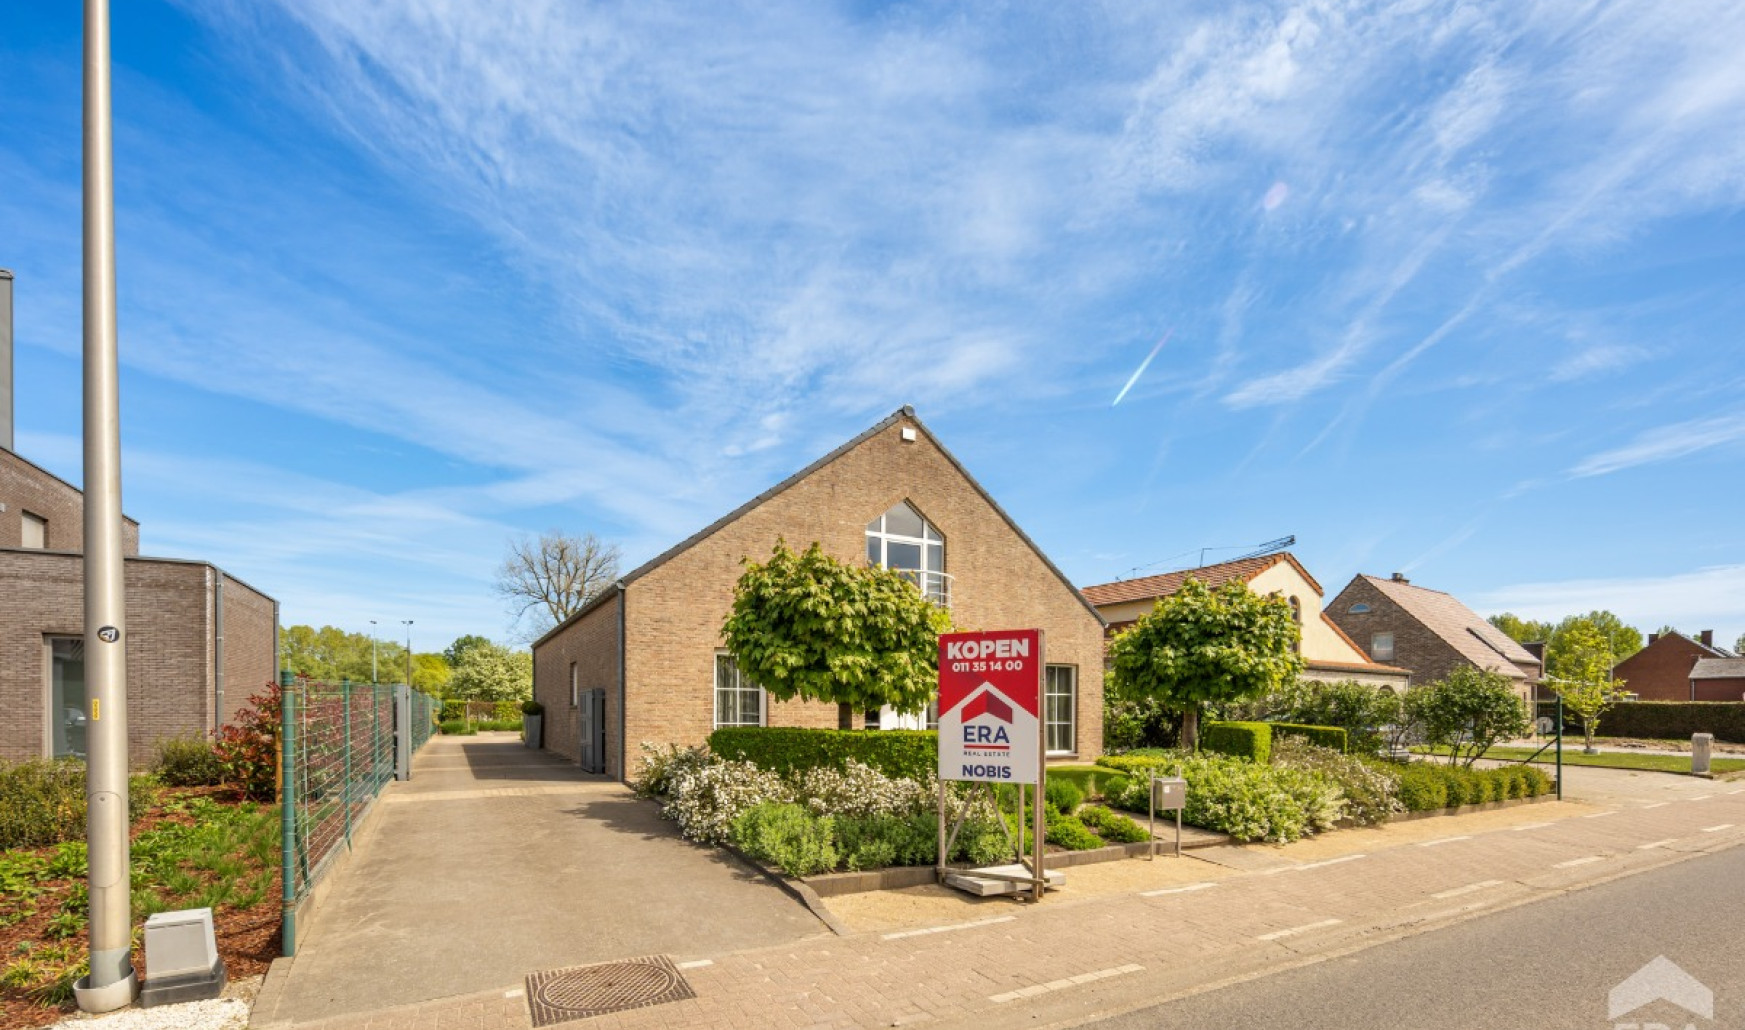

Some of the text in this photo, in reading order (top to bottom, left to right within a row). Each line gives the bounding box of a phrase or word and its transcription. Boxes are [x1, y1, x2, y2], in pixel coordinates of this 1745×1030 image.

[947, 638, 1029, 660] KOPEN
[952, 660, 1023, 672] 011 35 14 00
[963, 725, 1010, 744] ERA
[962, 764, 1012, 779] NOBIS
